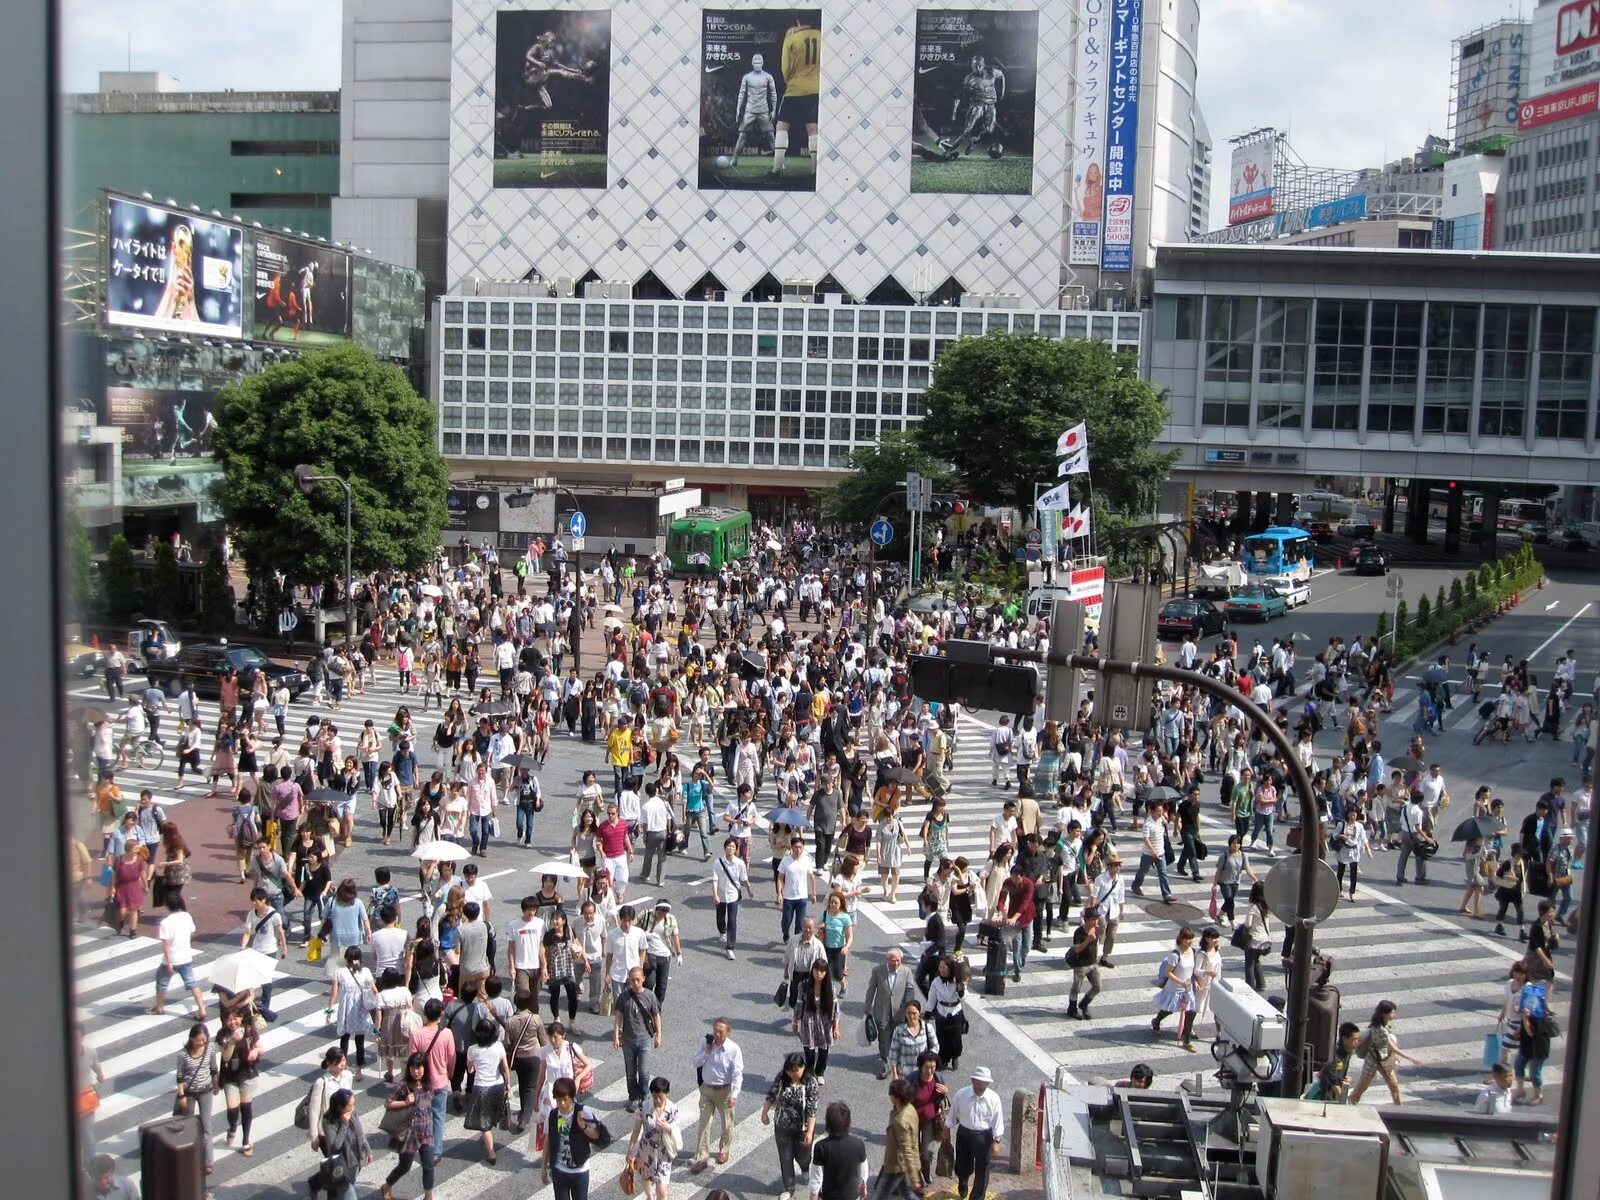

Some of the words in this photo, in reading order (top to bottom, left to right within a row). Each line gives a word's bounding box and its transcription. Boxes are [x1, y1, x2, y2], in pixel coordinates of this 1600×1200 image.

[705, 53, 741, 61] かきかえろ
[706, 44, 728, 52] 未来を
[1128, 0, 1140, 102] 010東急百貨店のお中元
[1537, 91, 1596, 118] 三菱東京UFJ銀行
[113, 238, 167, 260] ハイライトは
